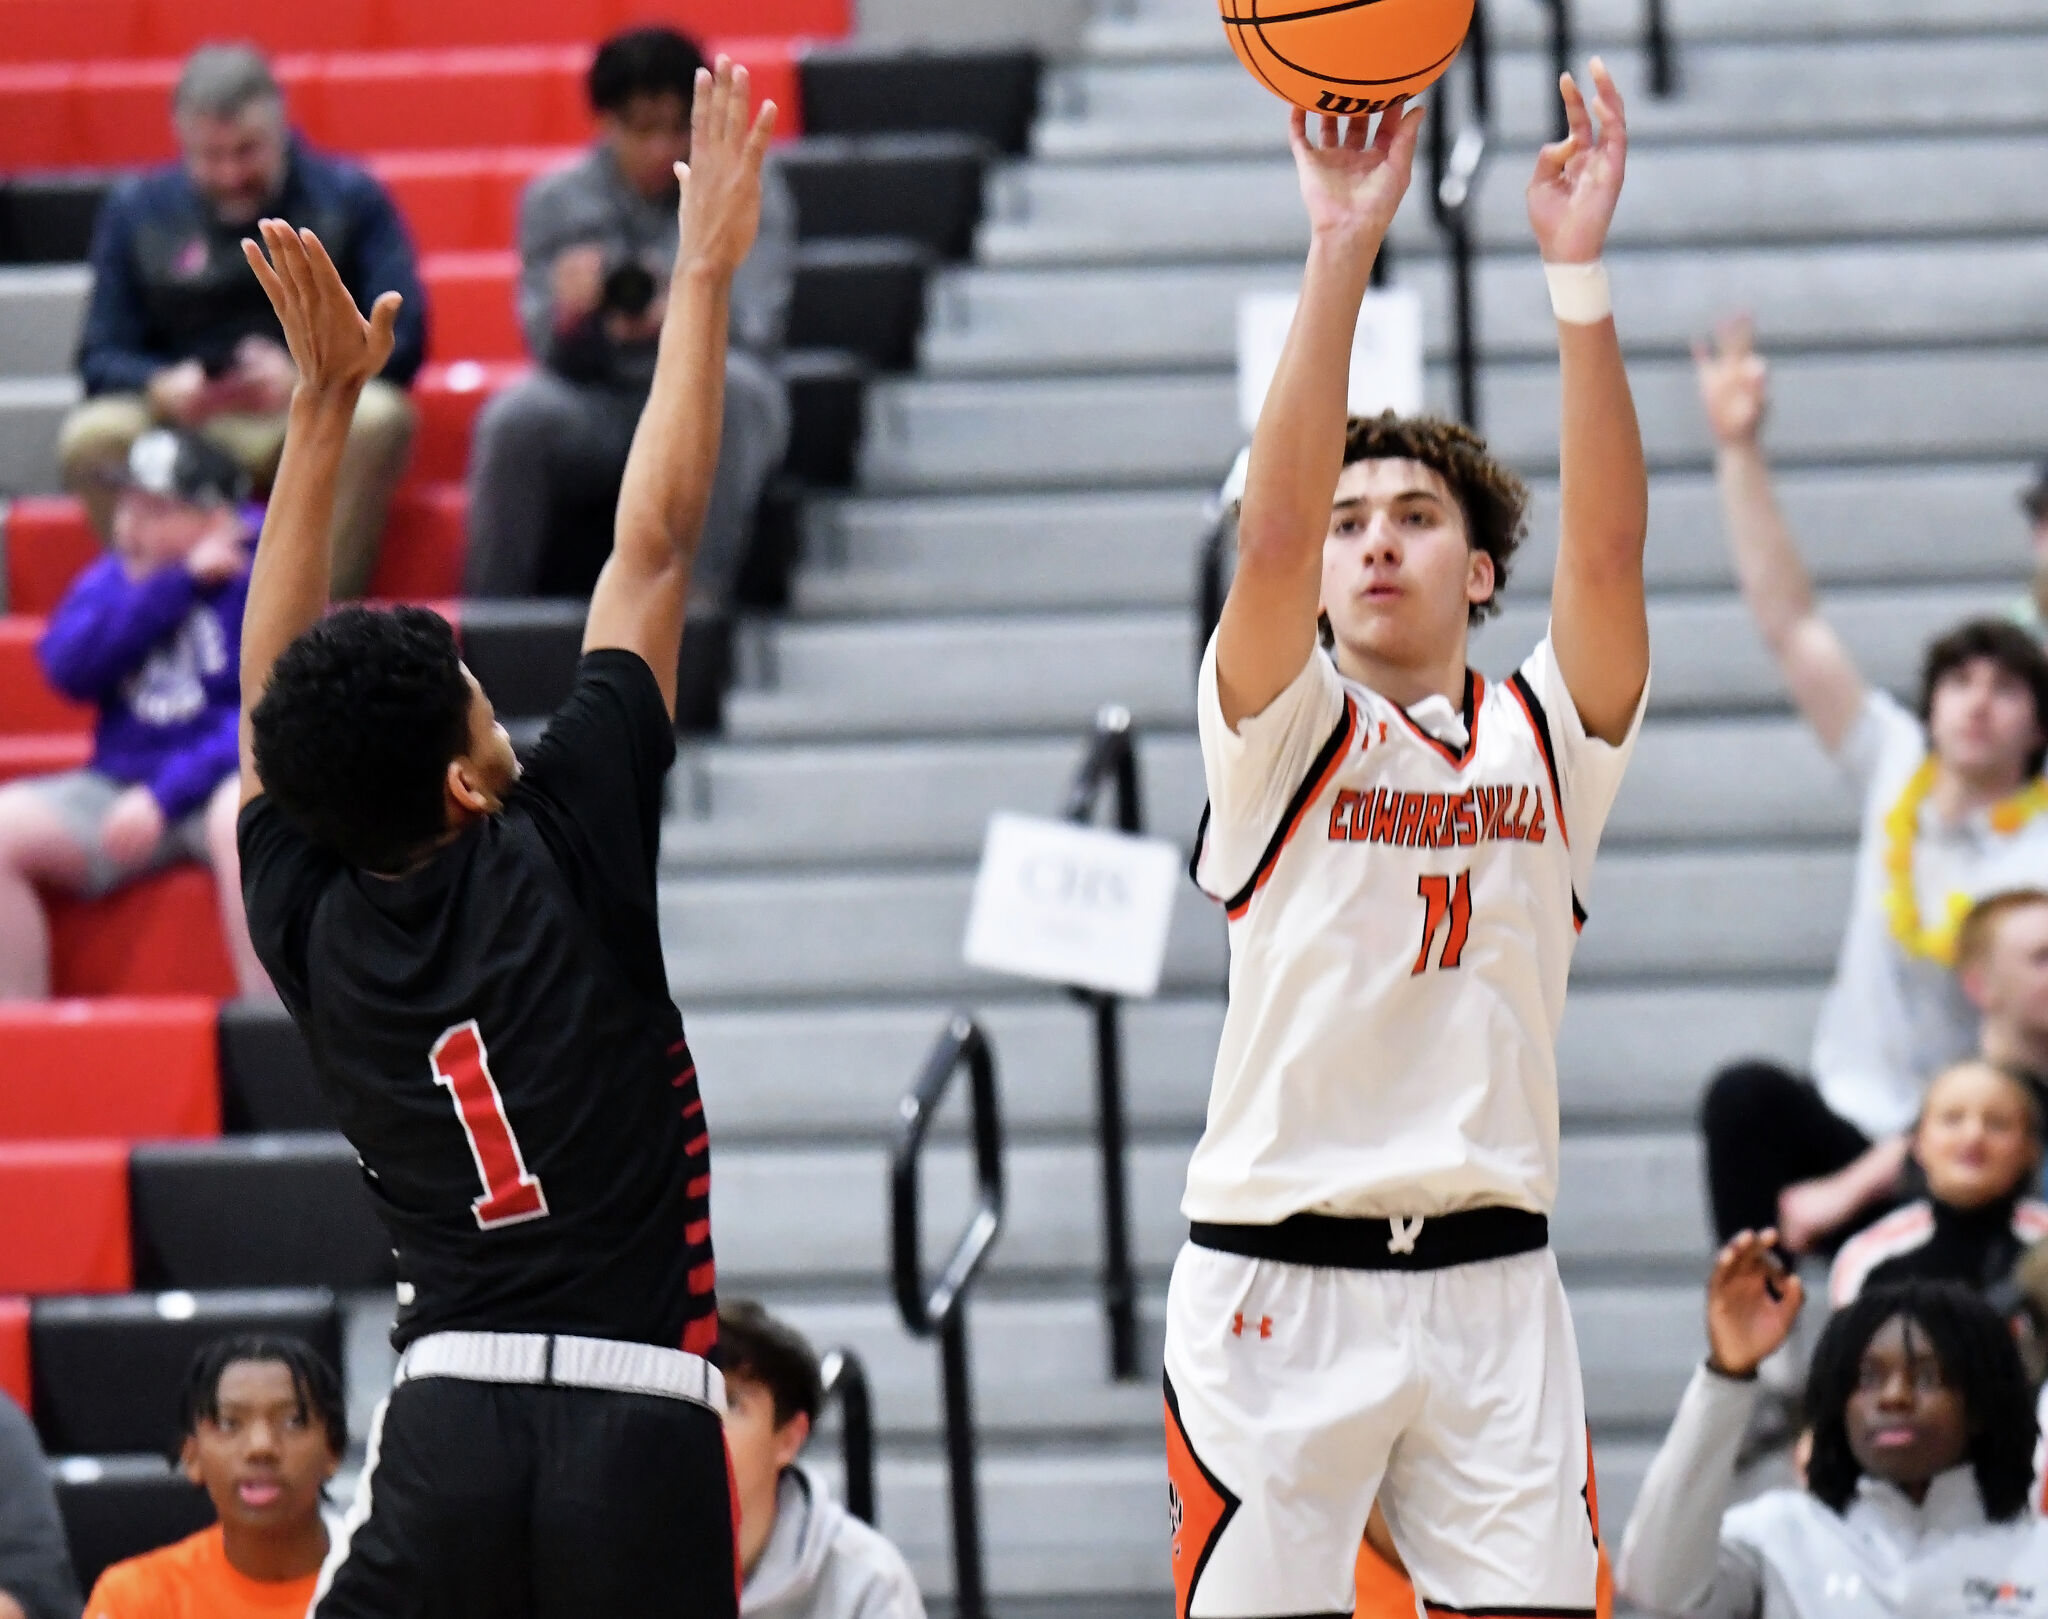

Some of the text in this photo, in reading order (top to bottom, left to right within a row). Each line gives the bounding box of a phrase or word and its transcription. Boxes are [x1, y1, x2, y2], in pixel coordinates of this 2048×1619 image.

[1315, 90, 1416, 114] Wil
[1410, 867, 1473, 977] 11
[428, 1018, 550, 1231] 1
